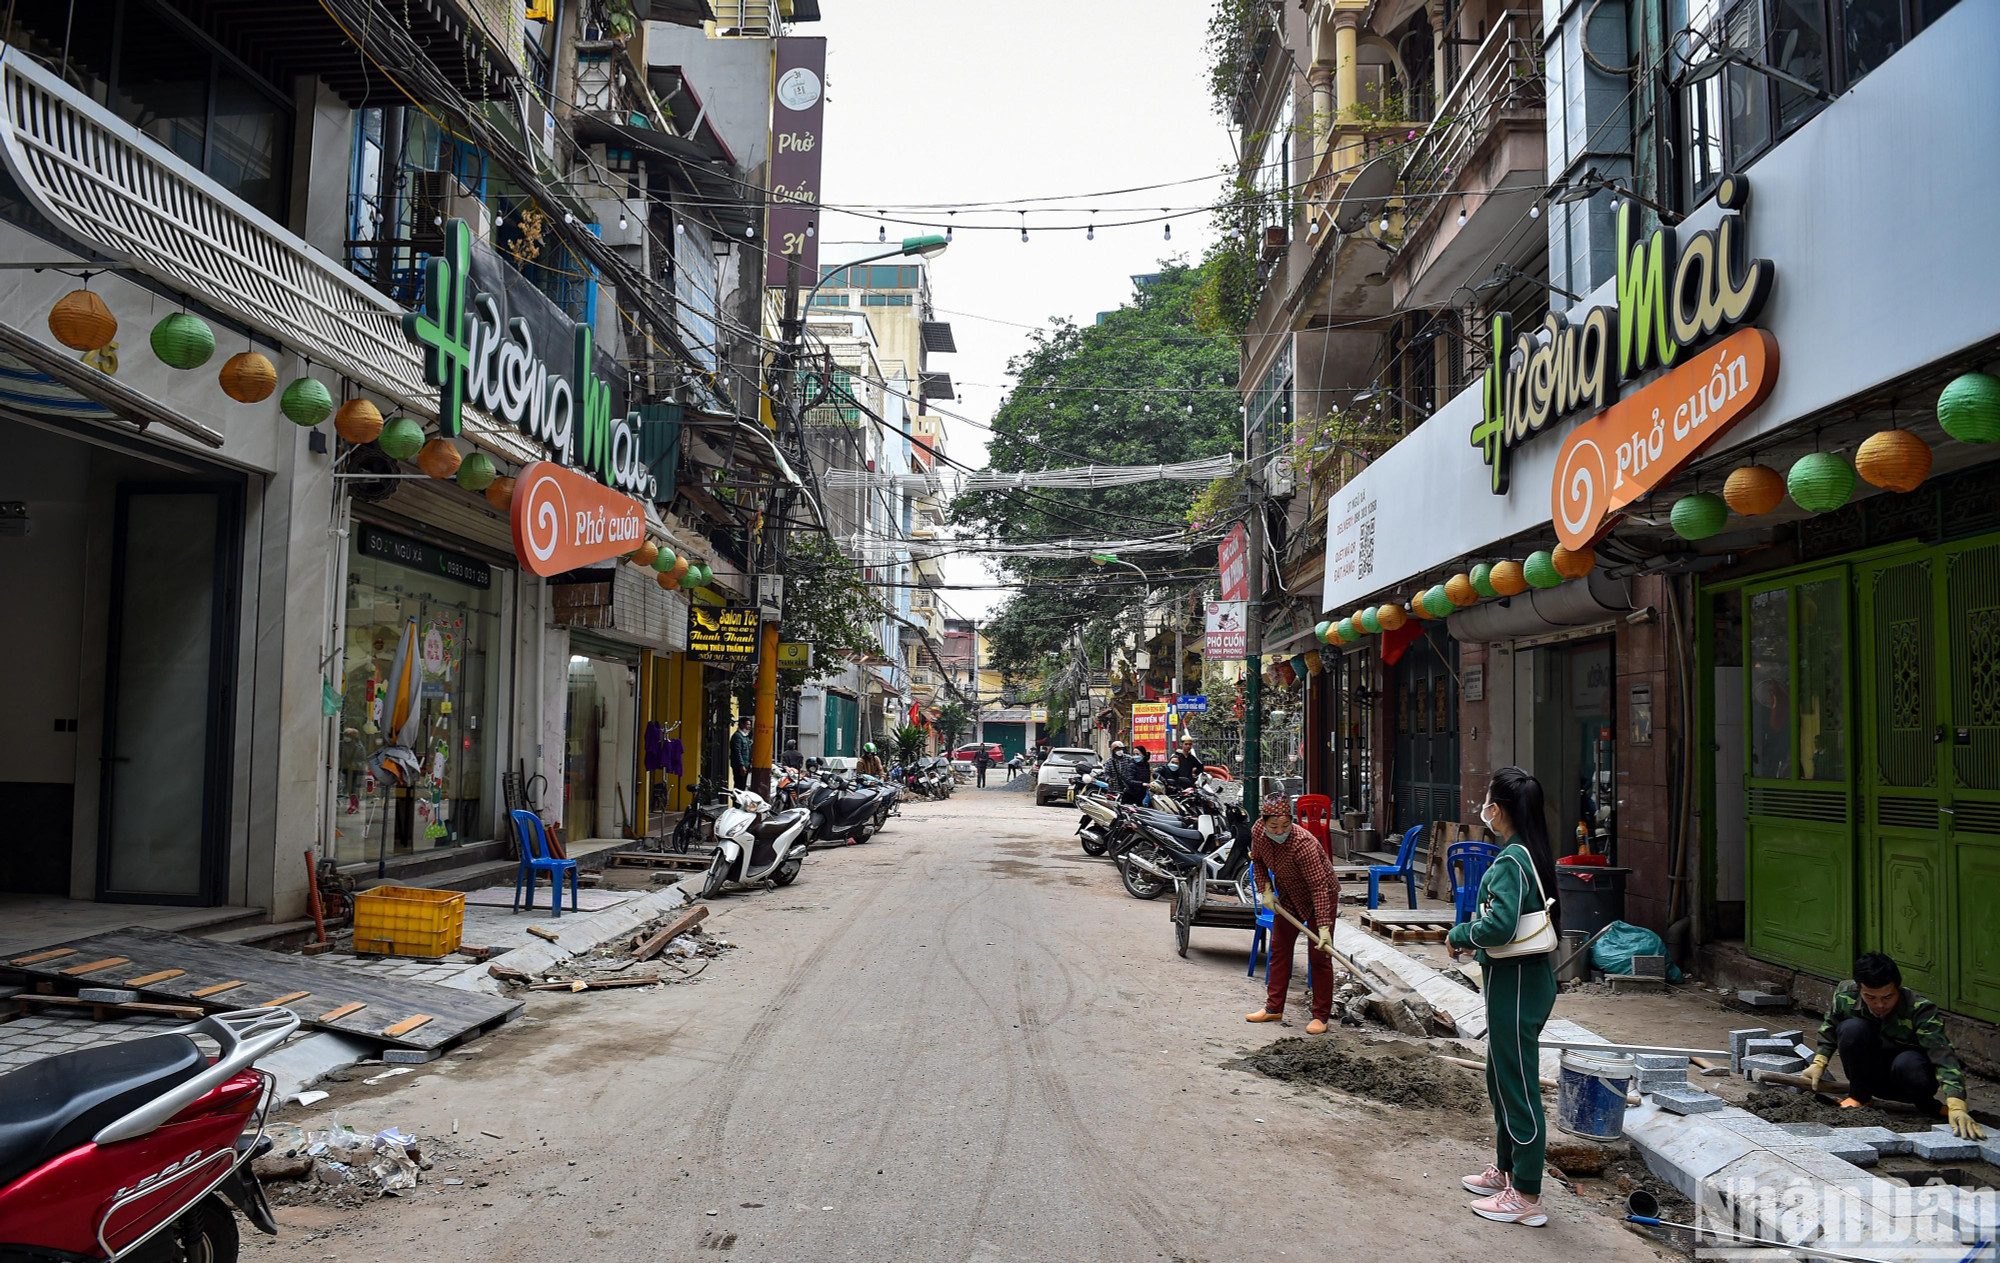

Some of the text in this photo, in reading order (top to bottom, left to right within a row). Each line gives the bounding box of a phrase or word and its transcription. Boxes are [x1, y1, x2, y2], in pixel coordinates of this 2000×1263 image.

[778, 131, 815, 154] Phở
[772, 180, 817, 204] Cuốn
[780, 232, 805, 255] 31
[1612, 350, 1749, 490] Phở cuốn
[574, 505, 640, 546] Phở cuốn
[719, 608, 759, 627] Salon Tóc
[689, 631, 755, 643] Thanh Thanh
[112, 1150, 202, 1201] LEAD
